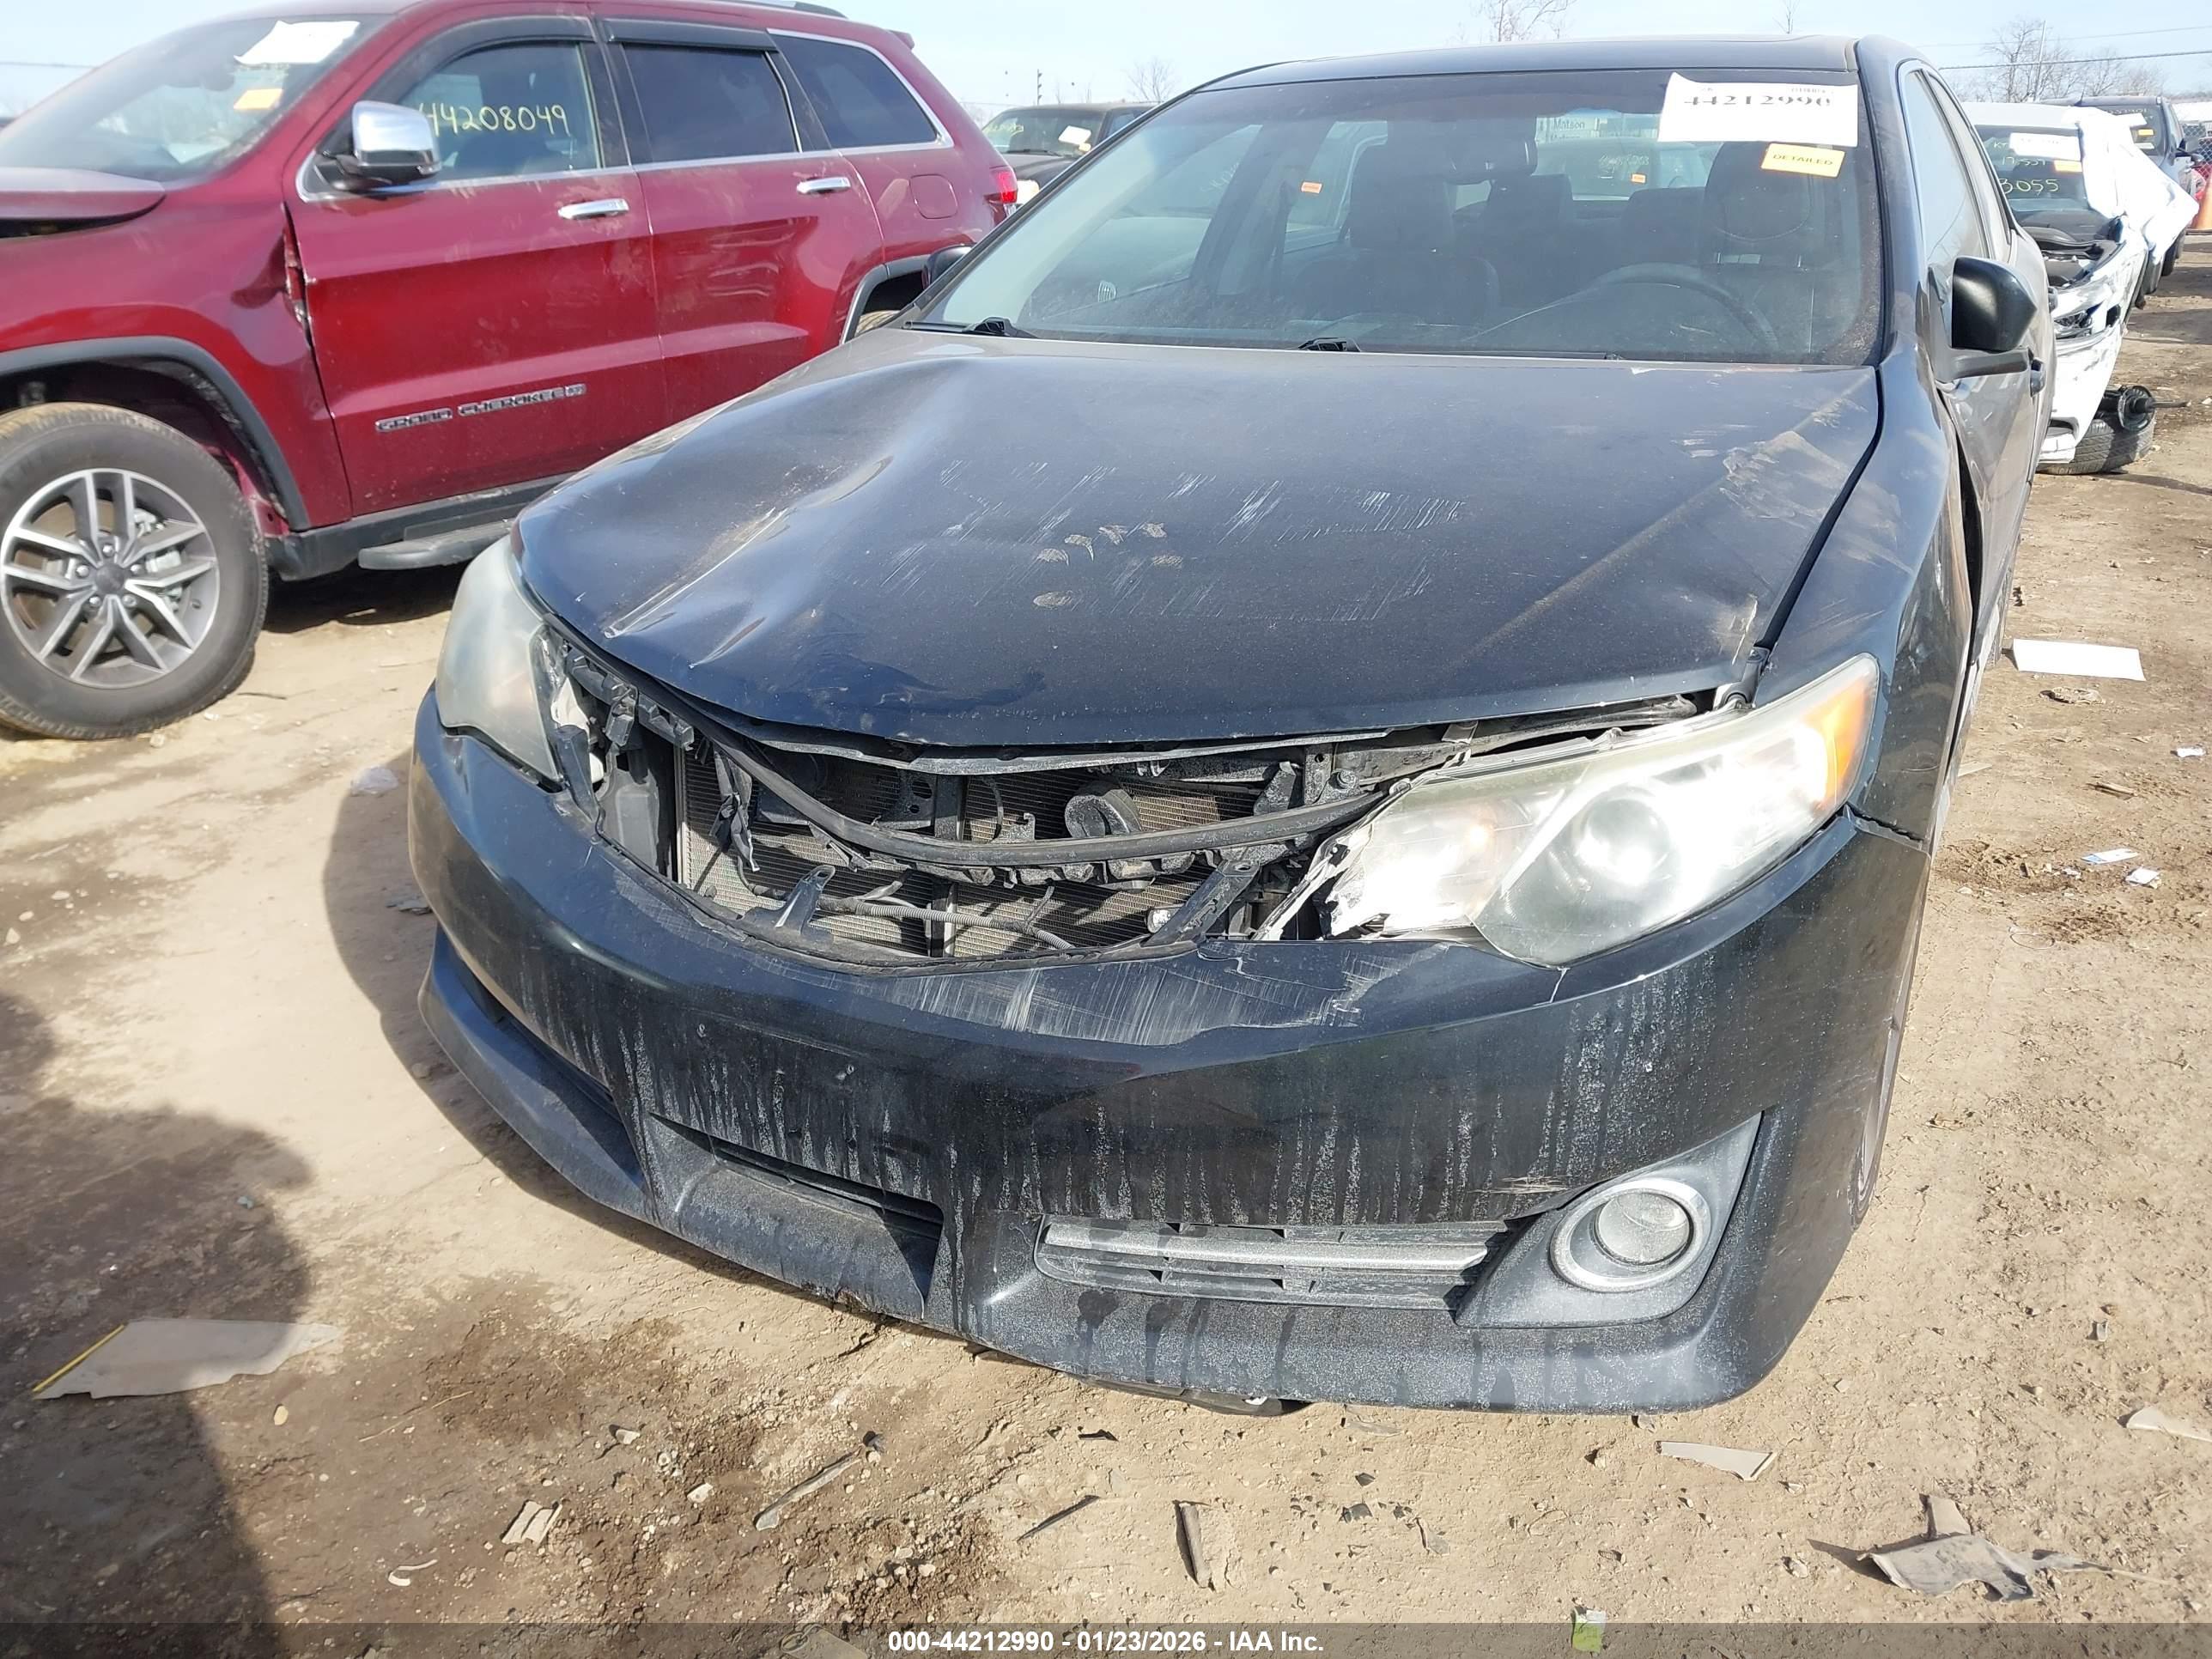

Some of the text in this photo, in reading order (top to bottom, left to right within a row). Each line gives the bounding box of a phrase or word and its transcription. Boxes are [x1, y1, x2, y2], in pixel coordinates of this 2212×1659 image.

[418, 102, 570, 137] 44208049
[1772, 153, 1833, 166] DETAILED
[375, 408, 453, 432] GRAND
[457, 386, 565, 417] CHEROKEE
